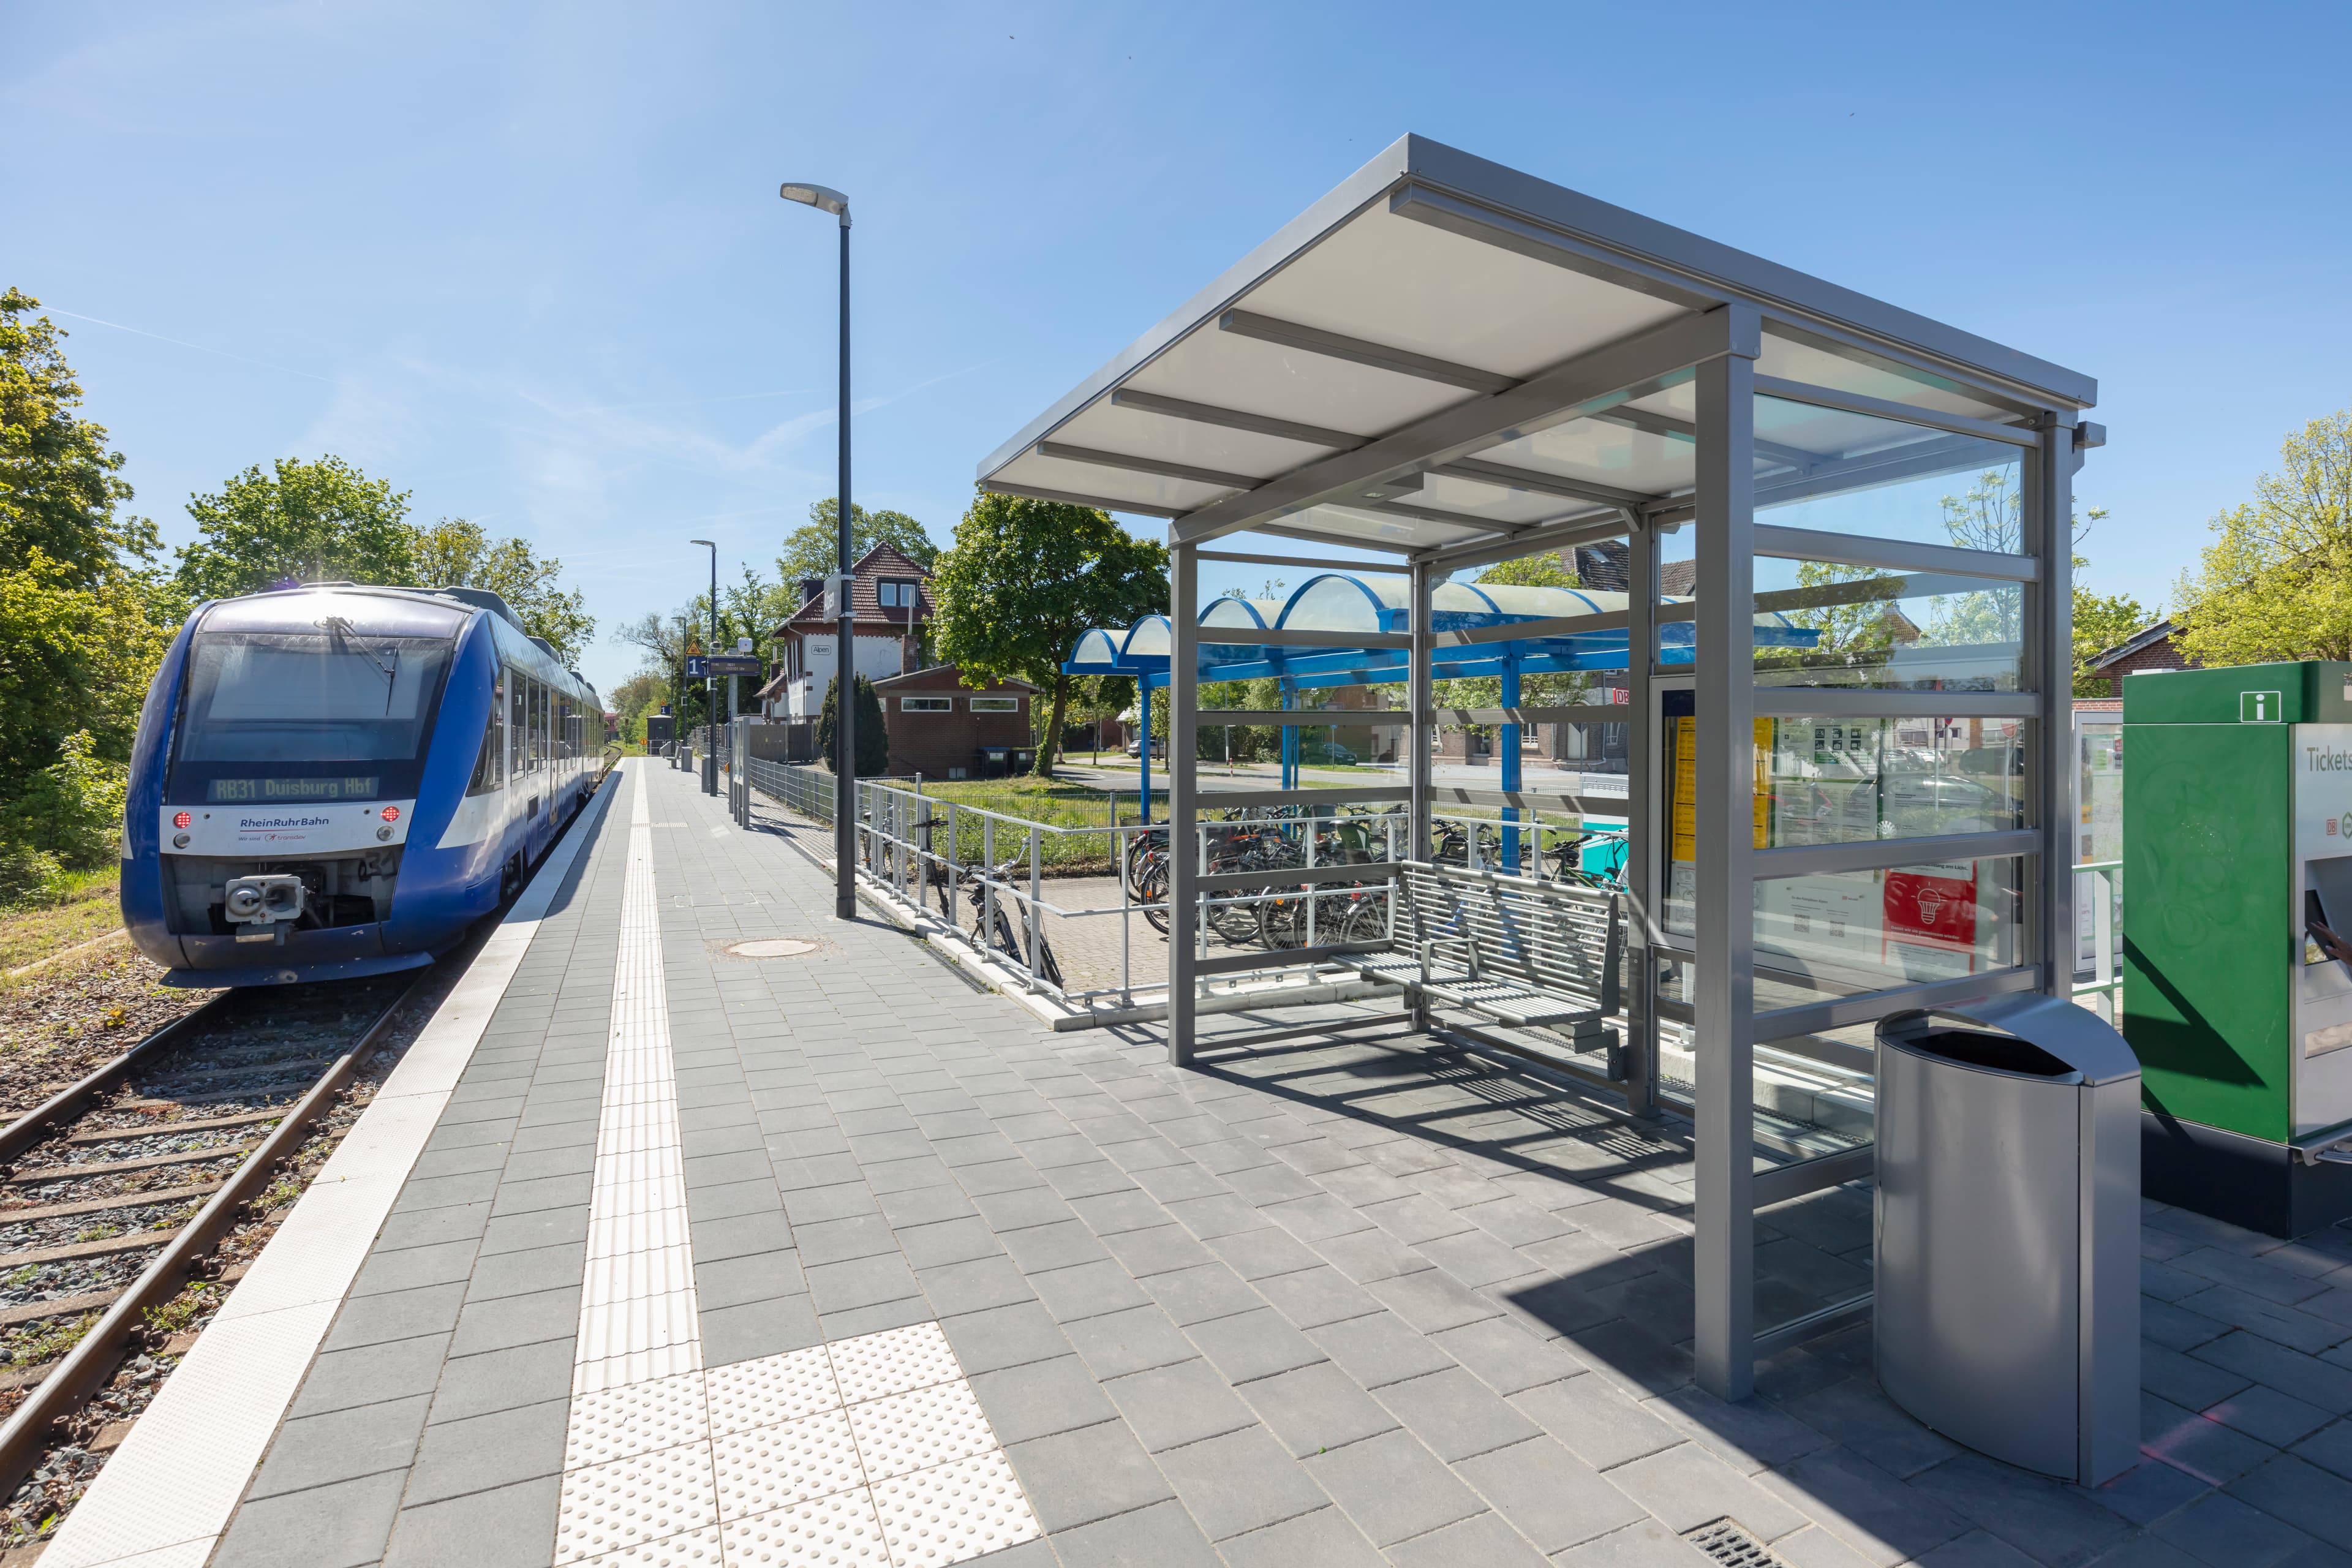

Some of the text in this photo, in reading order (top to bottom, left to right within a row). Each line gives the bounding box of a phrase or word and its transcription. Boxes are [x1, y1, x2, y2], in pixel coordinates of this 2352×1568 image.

[689, 659, 698, 674] 1
[1617, 691, 1629, 703] DB
[2307, 745, 2352, 772] Tickets
[216, 777, 372, 799] RB31 Duisburg Hbf
[241, 816, 330, 827] RheinRuhrBahn
[2328, 821, 2335, 833] DB
